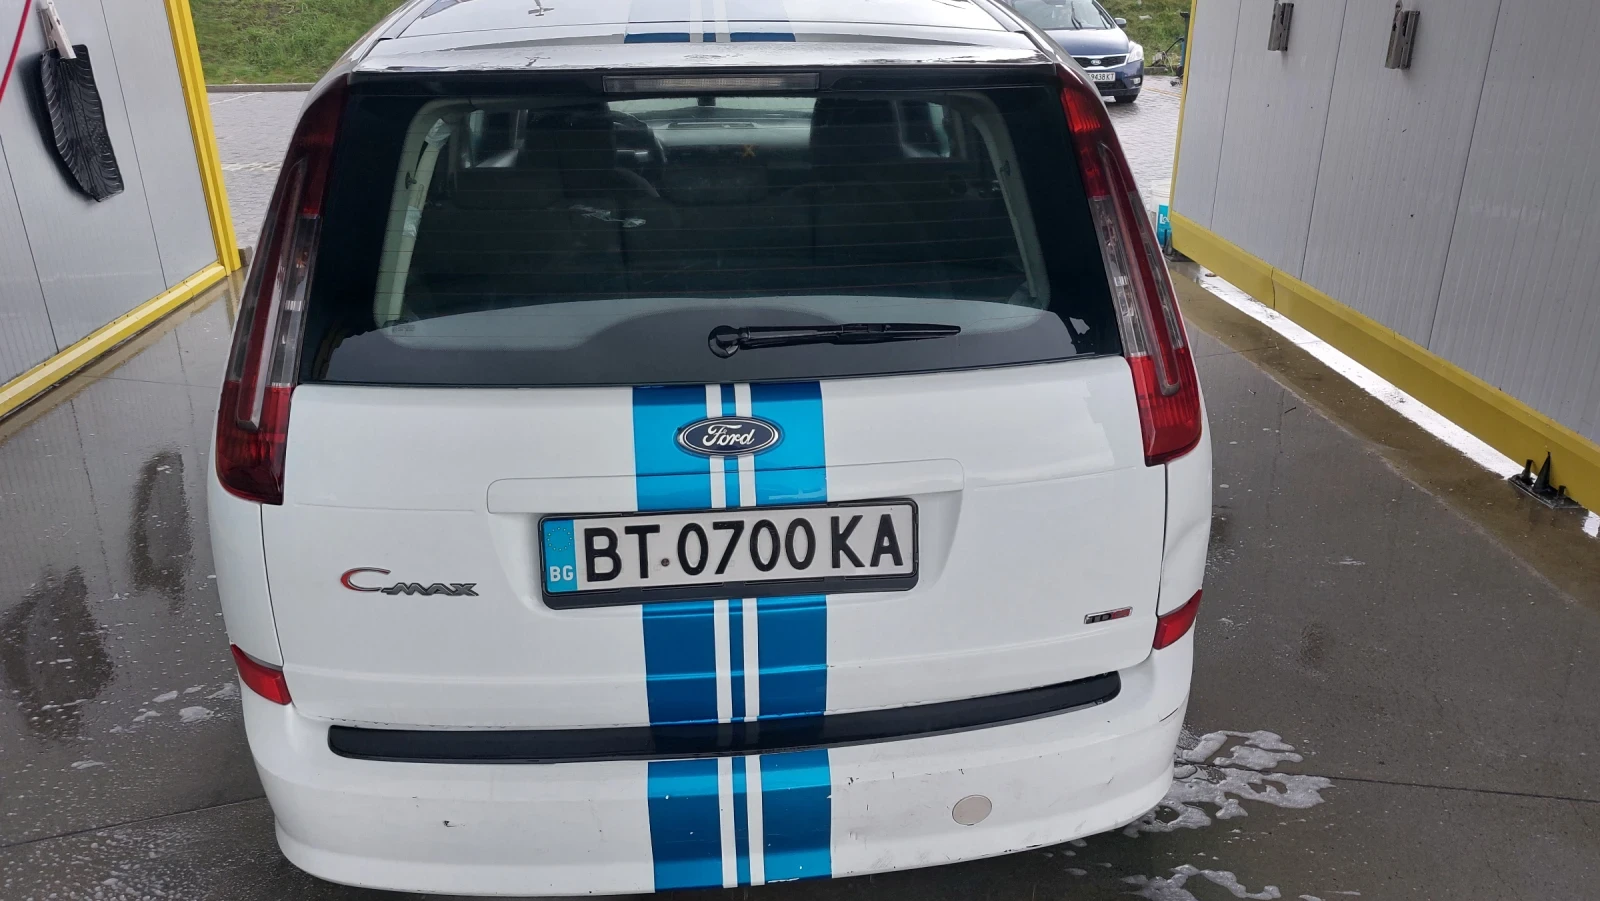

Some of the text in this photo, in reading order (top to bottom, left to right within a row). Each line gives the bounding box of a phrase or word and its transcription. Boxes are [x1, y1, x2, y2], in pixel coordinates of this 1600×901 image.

[702, 423, 756, 447] Ford
[584, 513, 904, 583] BT 0700 KA
[549, 564, 575, 584] BG
